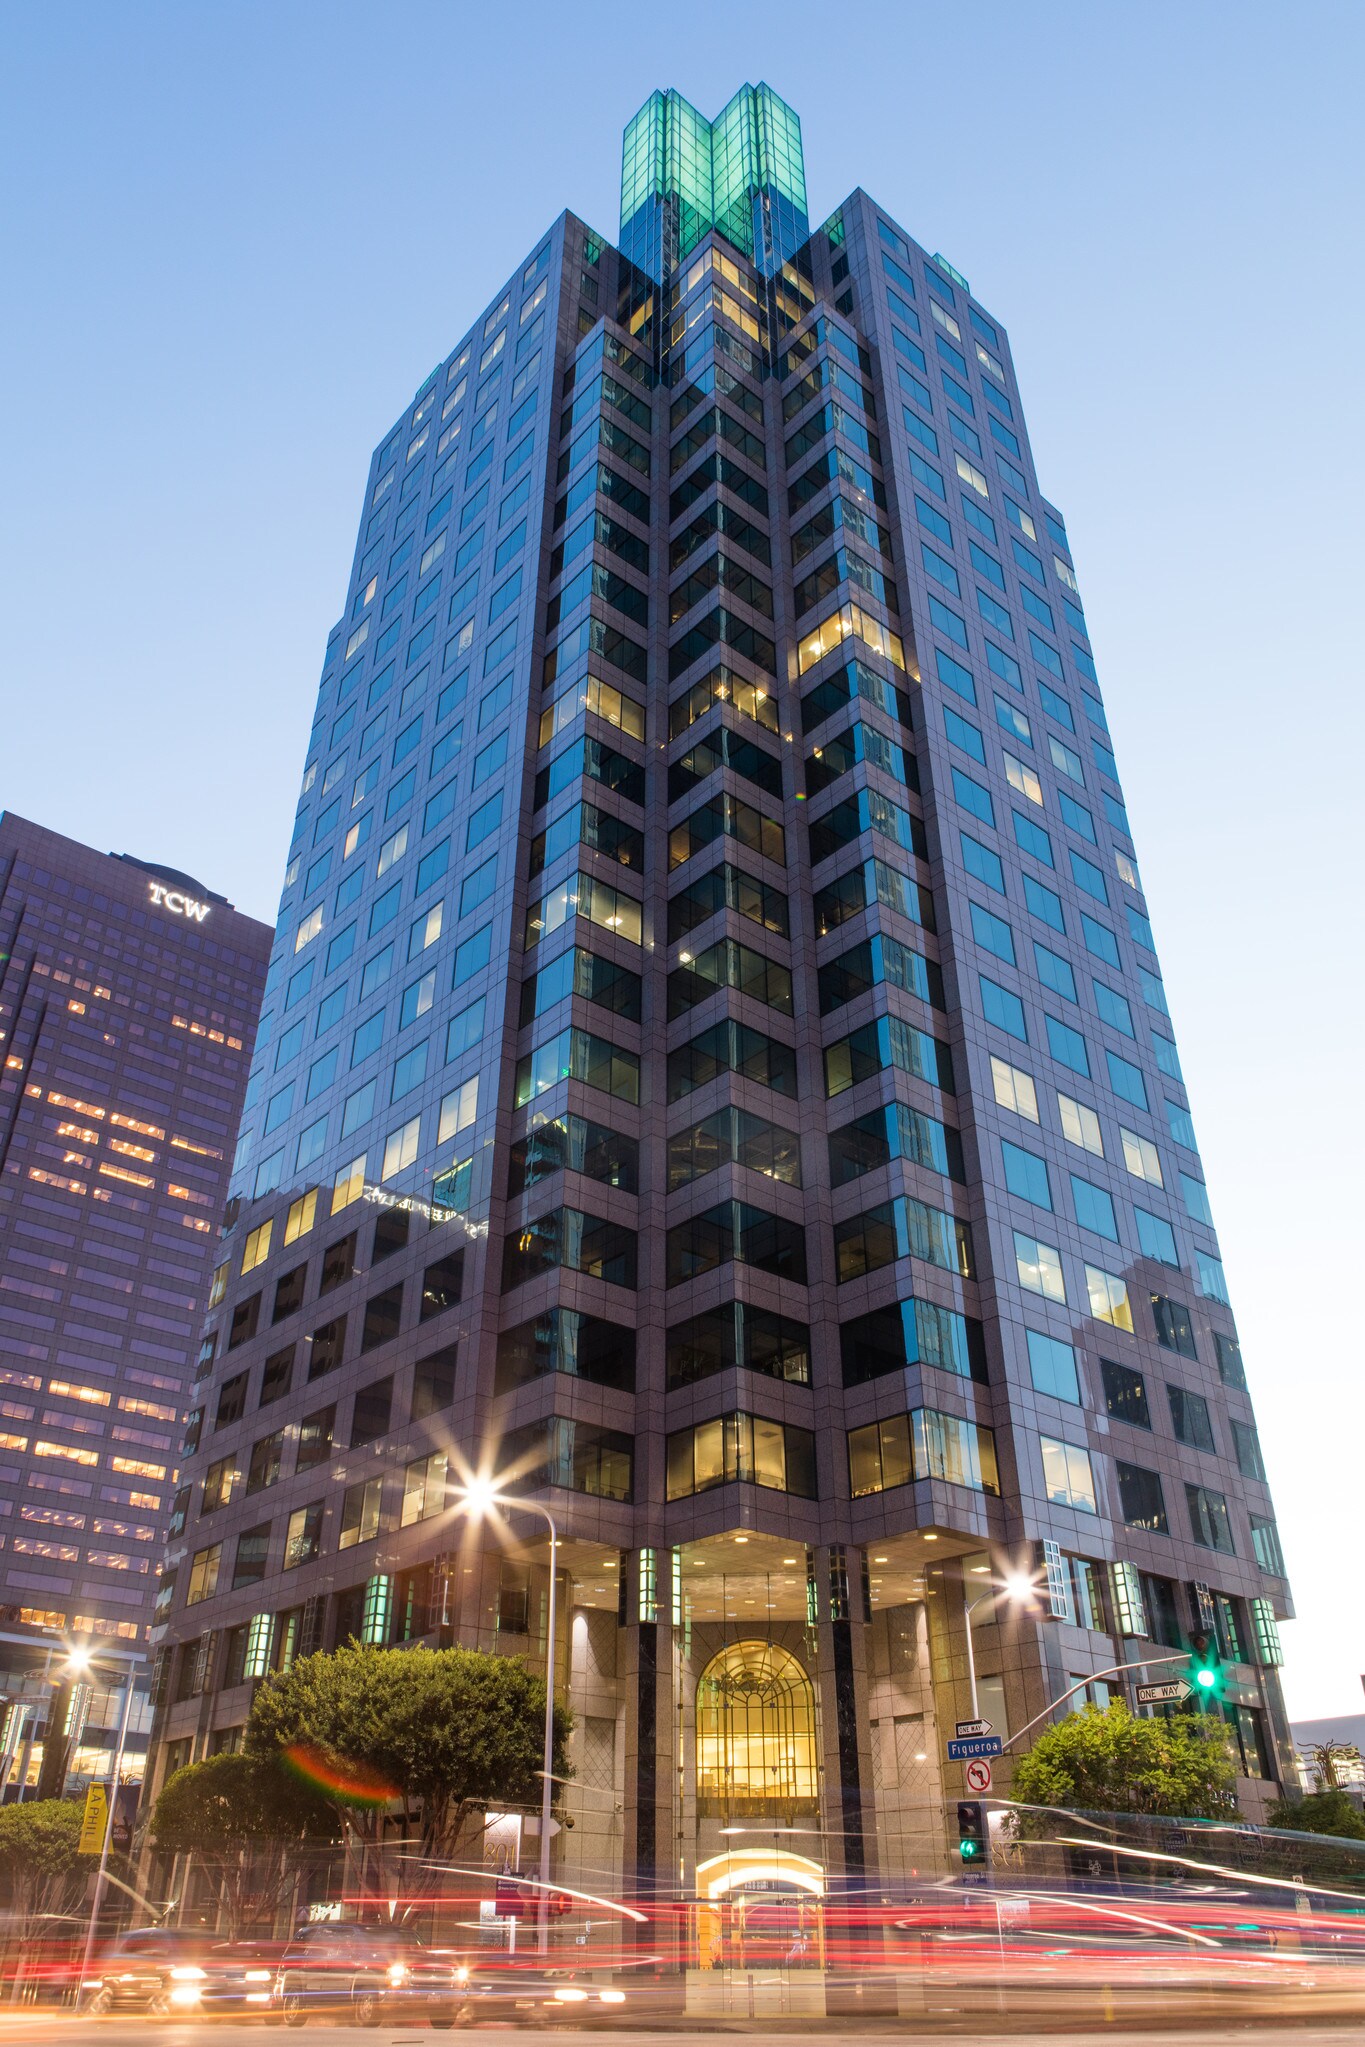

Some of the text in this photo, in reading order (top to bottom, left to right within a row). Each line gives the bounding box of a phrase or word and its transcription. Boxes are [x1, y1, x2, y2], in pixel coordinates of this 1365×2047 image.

[149, 882, 210, 922] TCW
[1140, 1685, 1179, 1700] ONE WAY
[959, 1726, 970, 1734] ONE
[951, 1742, 998, 1757] Figueroa
[91, 1785, 103, 1803] LA
[84, 1807, 100, 1838] PHIL
[483, 1842, 515, 1869] 801
